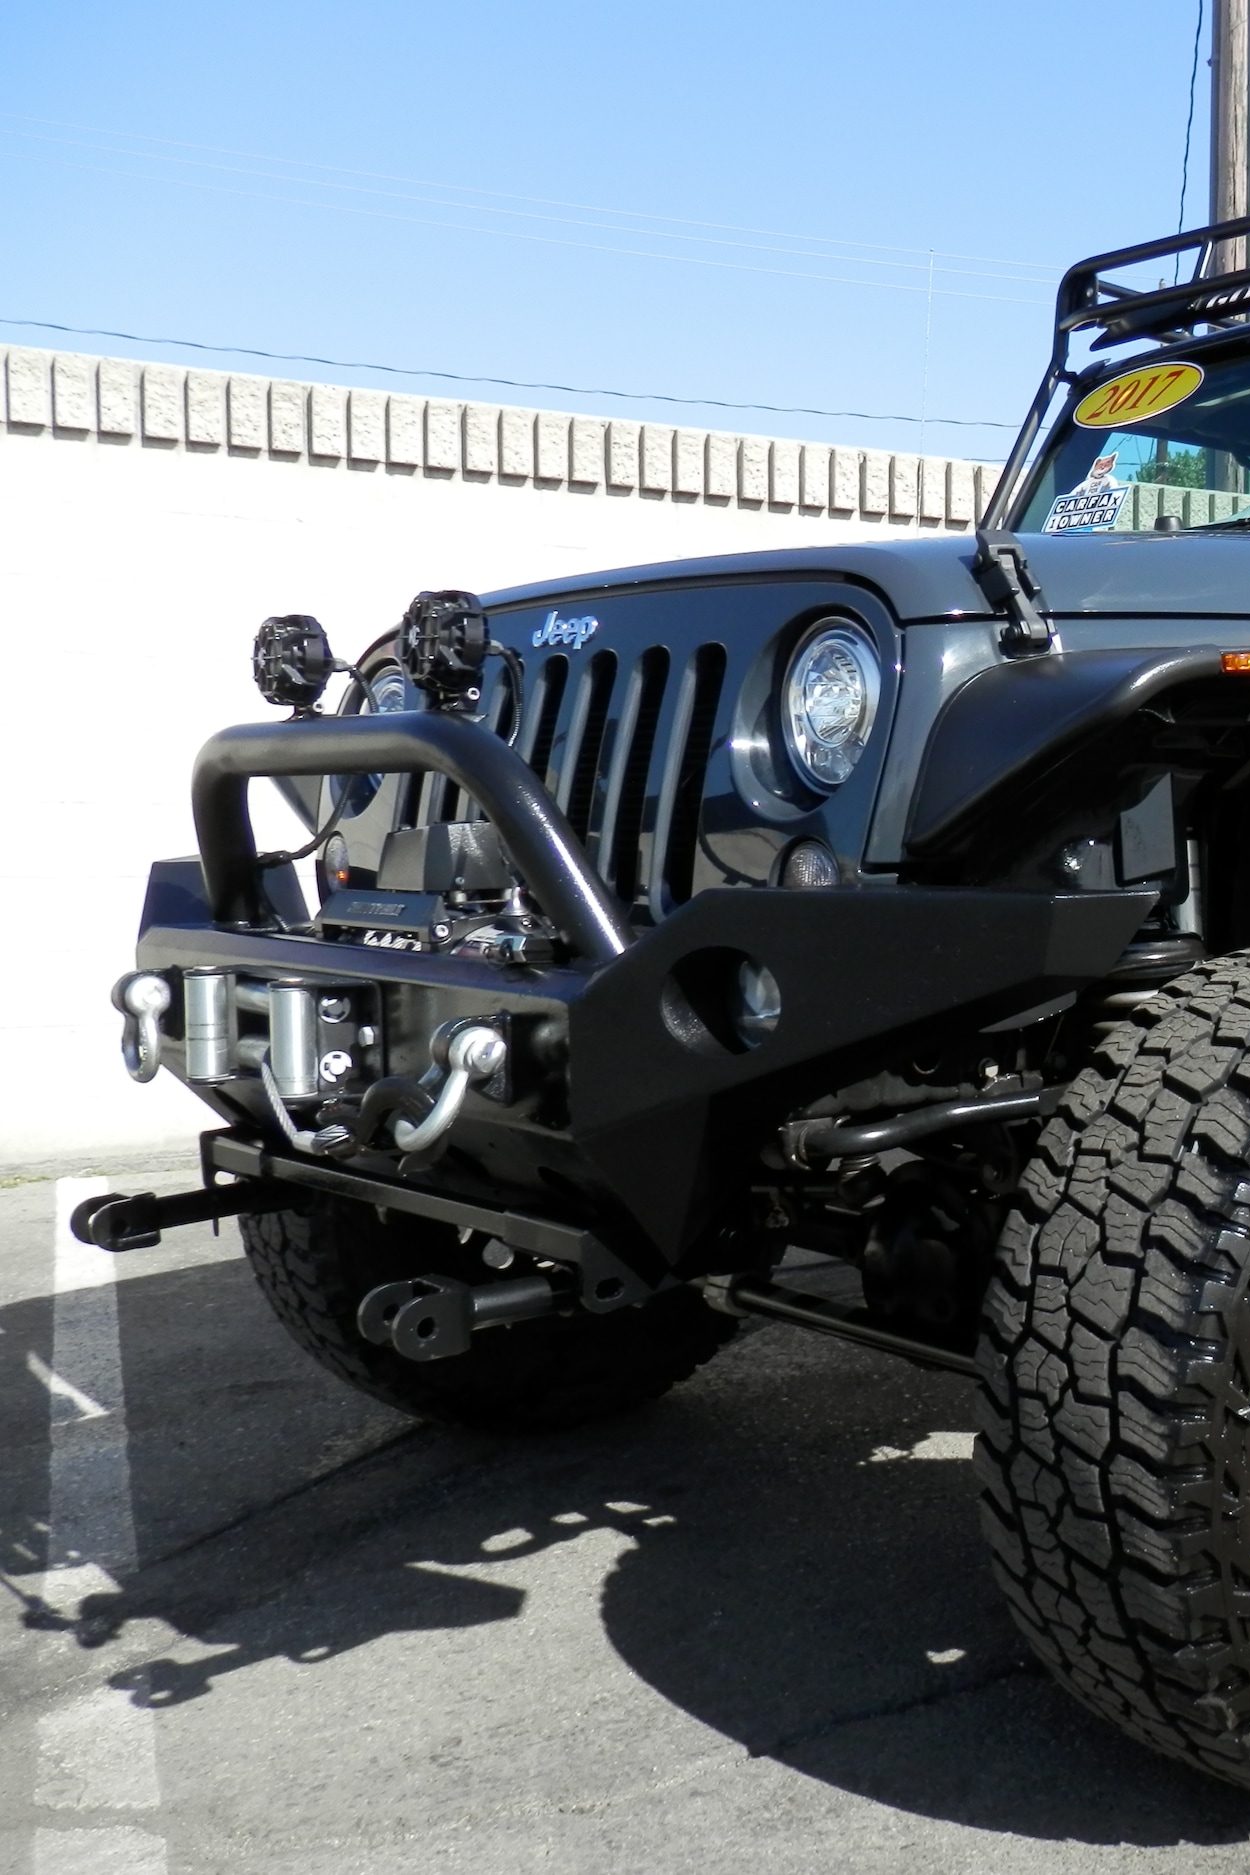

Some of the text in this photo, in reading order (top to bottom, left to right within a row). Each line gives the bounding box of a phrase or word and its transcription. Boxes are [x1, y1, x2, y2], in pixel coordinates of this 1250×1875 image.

[1085, 369, 1187, 421] 2017
[1054, 493, 1121, 514] CARFAX
[1058, 509, 1116, 530] OWNER
[532, 610, 599, 650] Jeep
